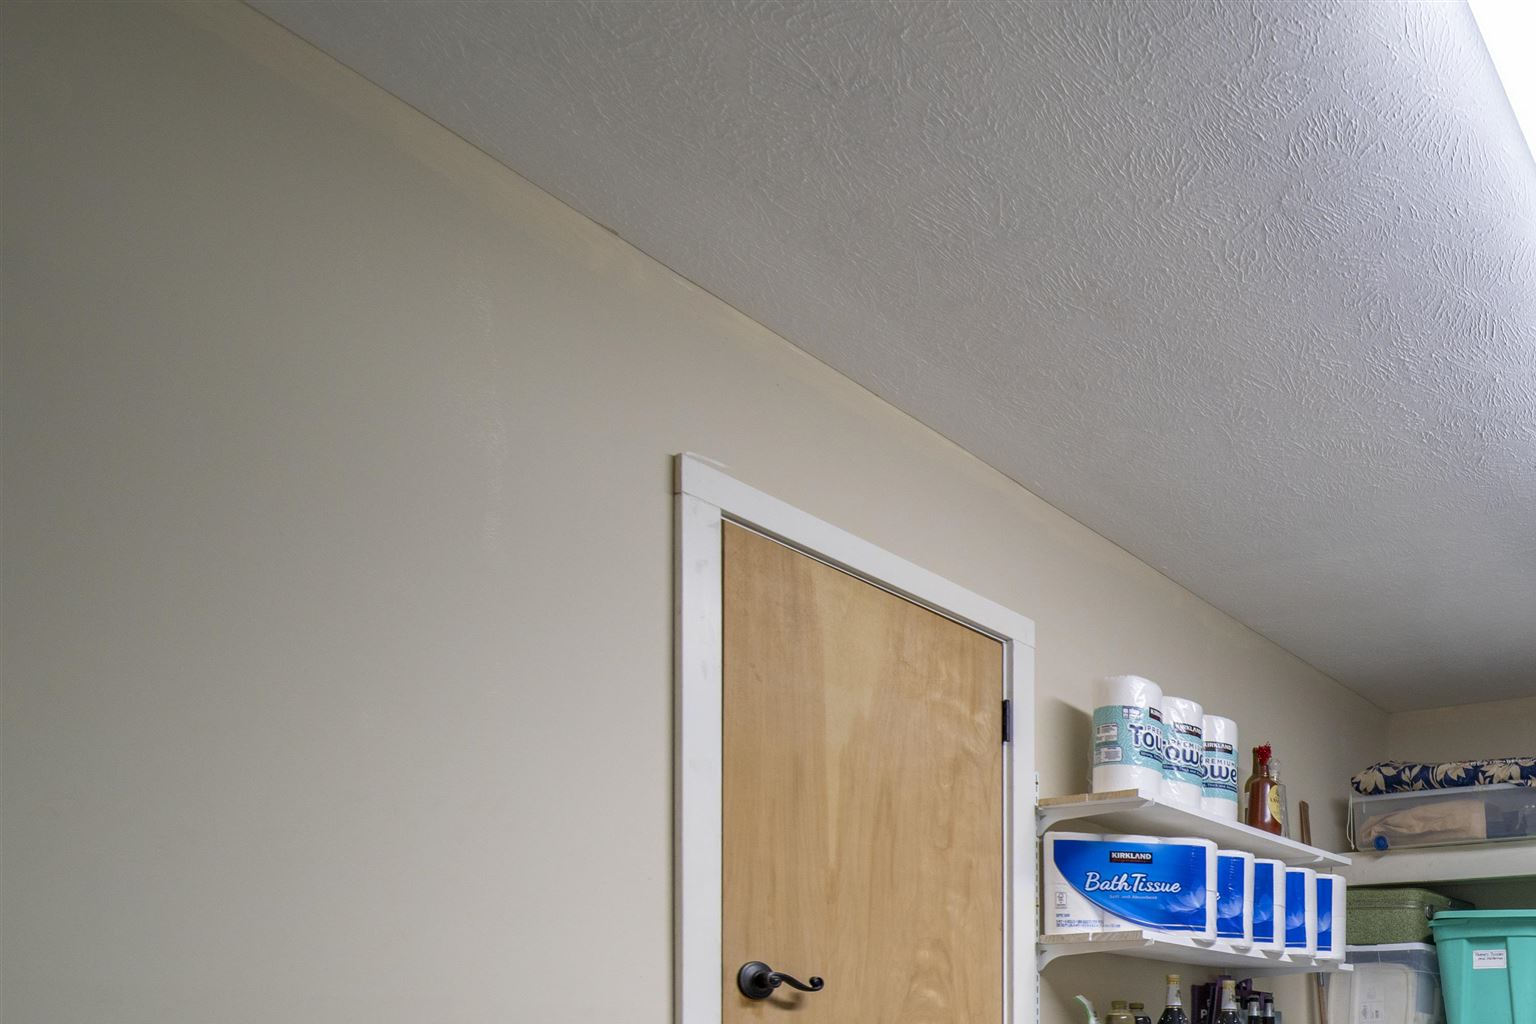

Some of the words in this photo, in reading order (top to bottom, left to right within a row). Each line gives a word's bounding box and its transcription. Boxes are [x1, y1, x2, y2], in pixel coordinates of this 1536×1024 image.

[1111, 852, 1152, 860] KIRKLAND
[1085, 871, 1132, 892] Bath
[1131, 873, 1182, 893] Tissue
